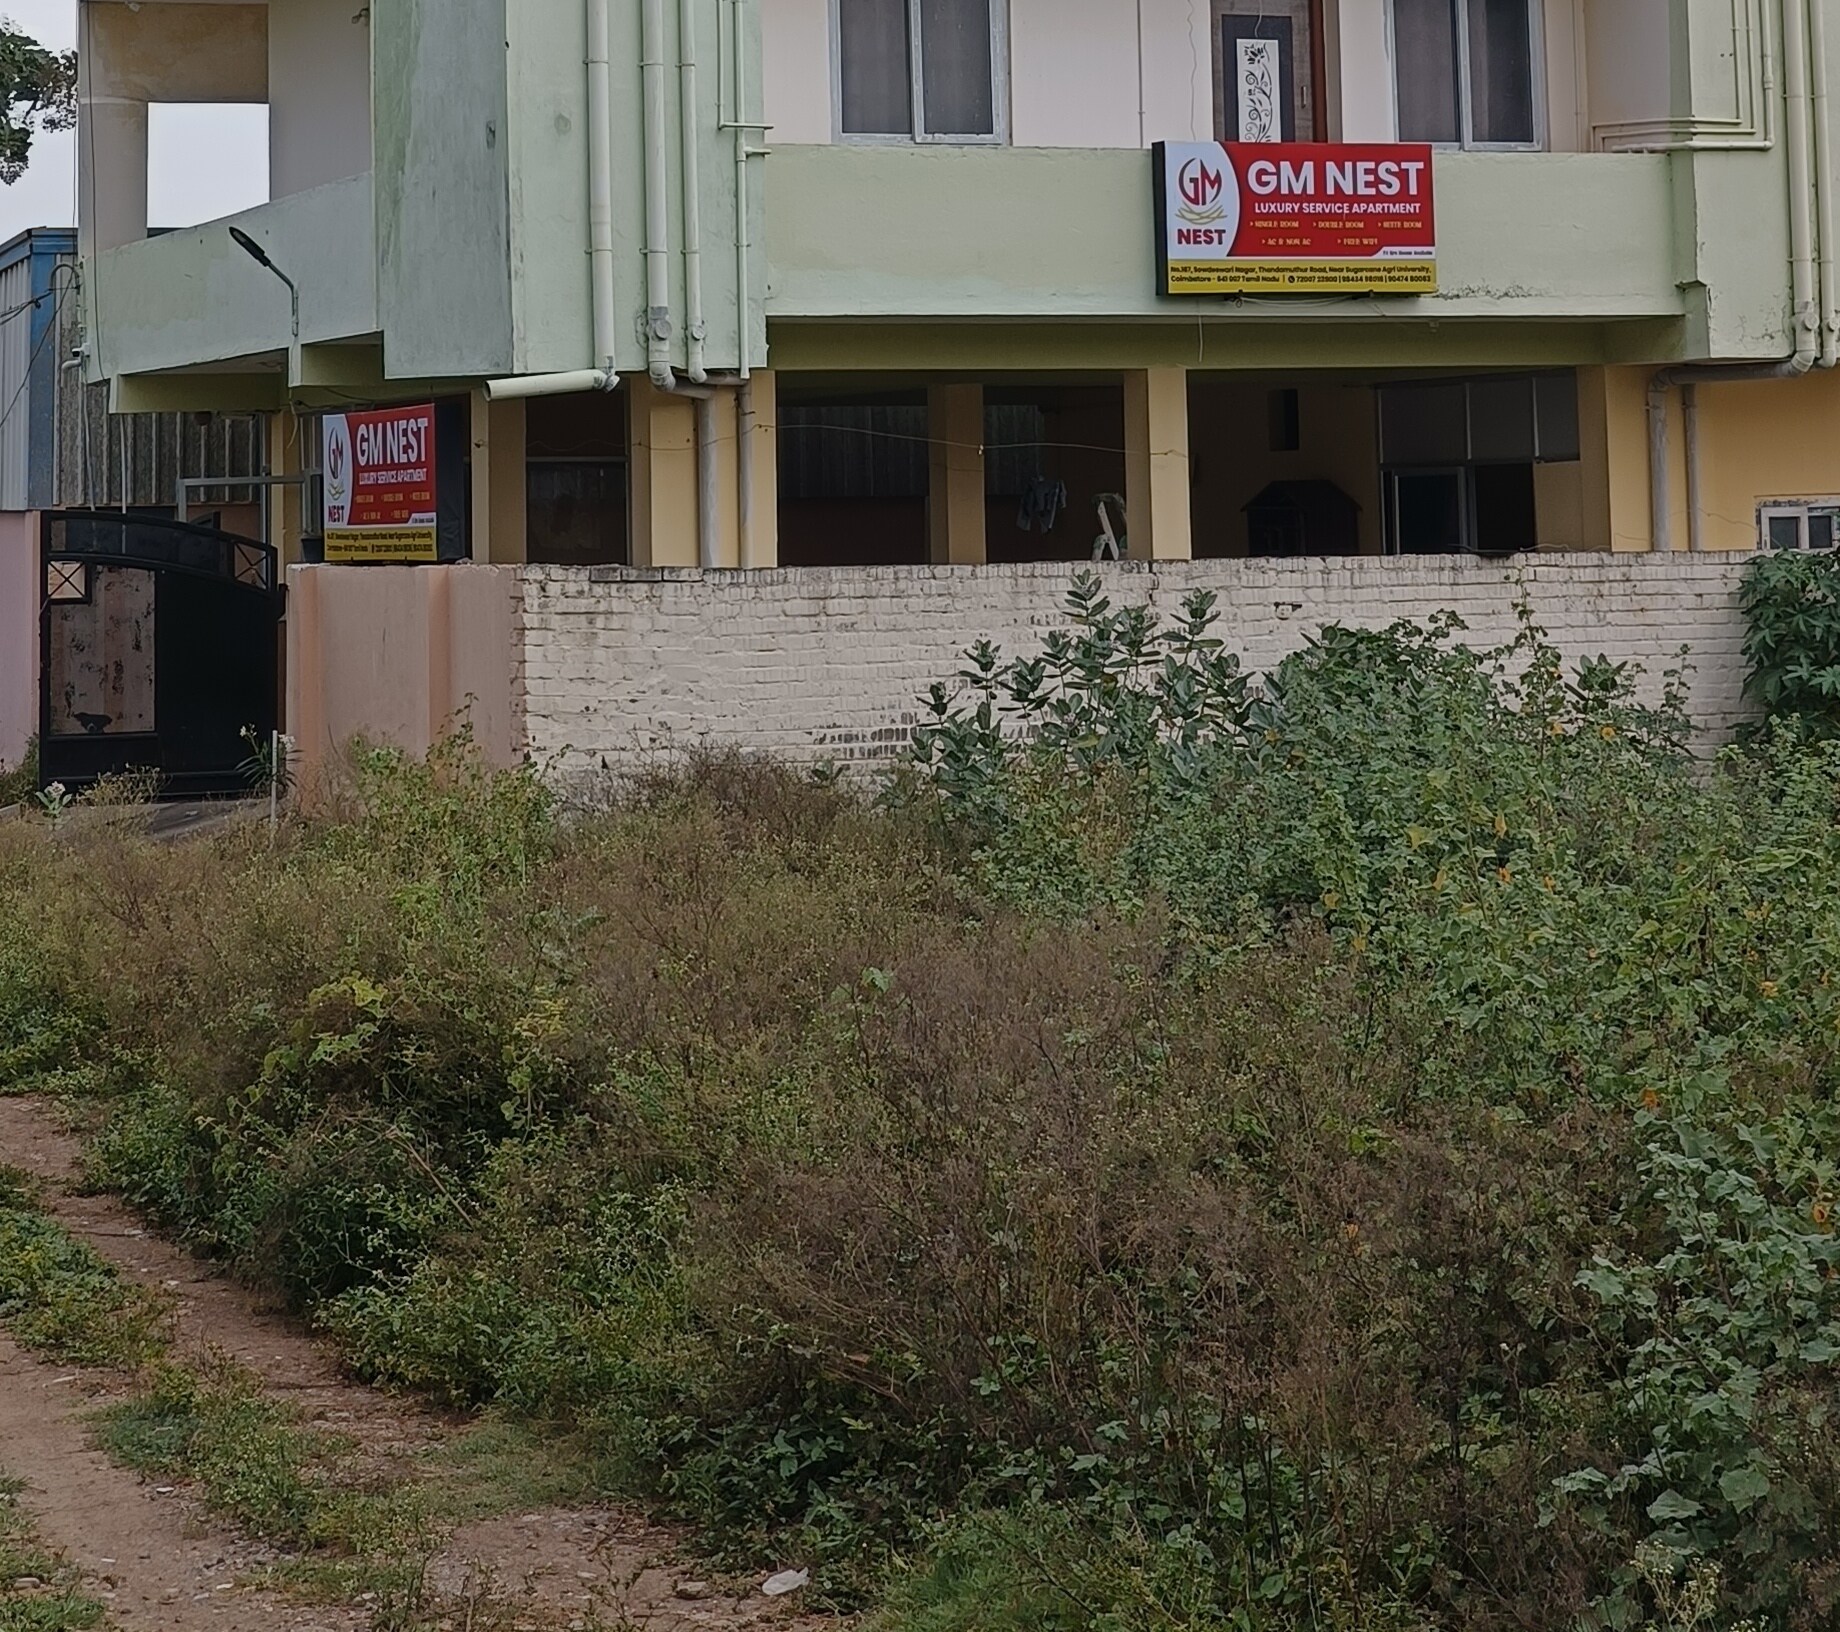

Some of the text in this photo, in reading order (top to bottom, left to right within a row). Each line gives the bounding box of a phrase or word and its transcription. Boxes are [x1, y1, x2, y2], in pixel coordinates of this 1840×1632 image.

[1247, 160, 1425, 196] GM NEST
[1254, 202, 1421, 214] LUXURY SERVICE APARTMENT
[1279, 220, 1299, 228] ROOM
[1177, 228, 1226, 245] NEST
[356, 417, 428, 466] GM NEST
[377, 470, 397, 484] SERVICE
[397, 468, 427, 482] APARTMENT
[328, 505, 345, 523] NEST
